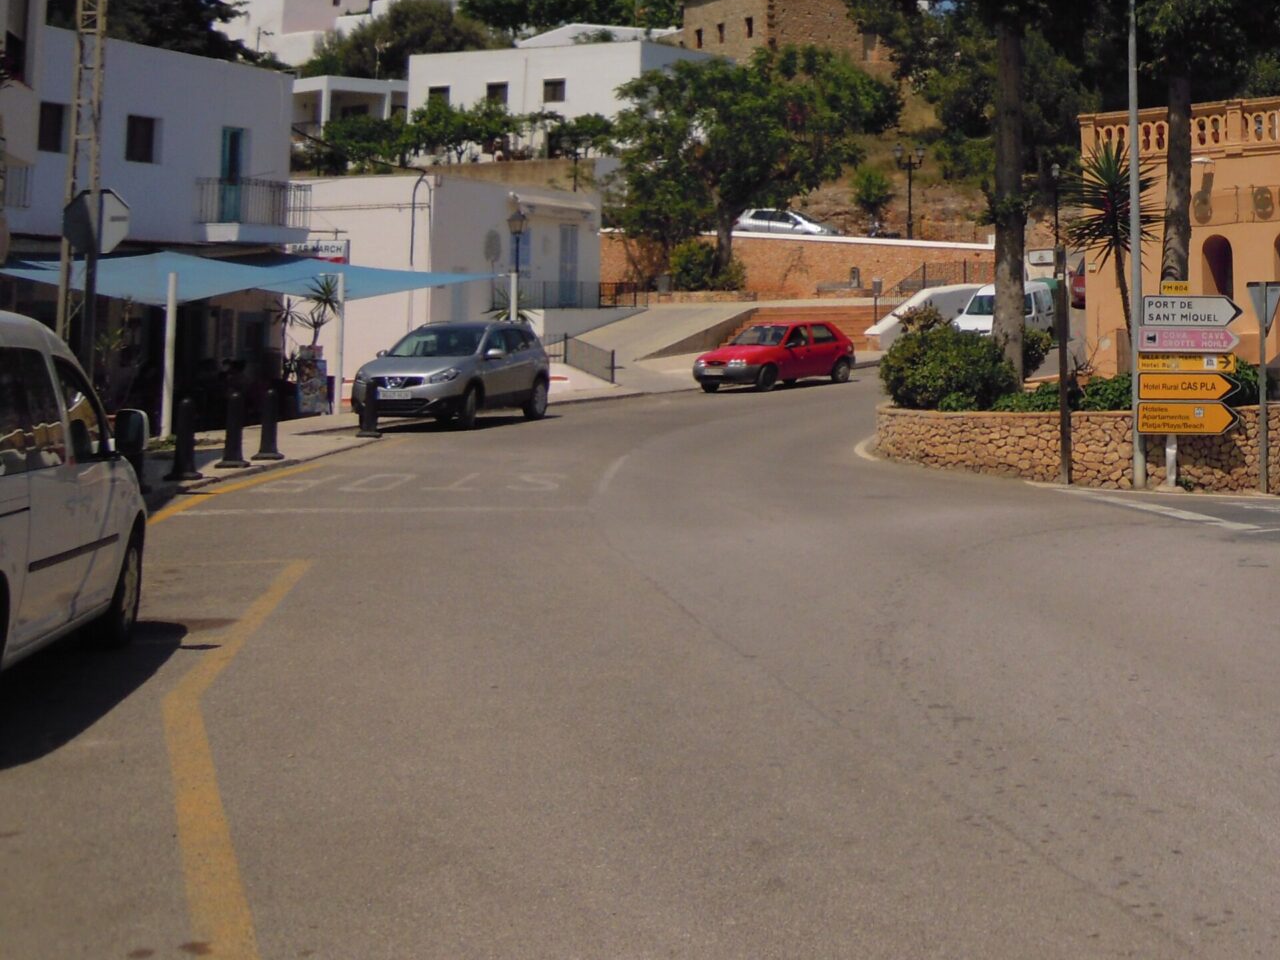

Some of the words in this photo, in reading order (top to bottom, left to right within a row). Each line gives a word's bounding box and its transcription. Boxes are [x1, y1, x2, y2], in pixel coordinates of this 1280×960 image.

[312, 244, 342, 253] MARCH
[1148, 301, 1176, 309] PORT
[1179, 301, 1193, 309] DE
[1148, 313, 1177, 321] SANT
[1180, 382, 1198, 390] CAS
[1200, 382, 1216, 391] PLA
[1142, 413, 1190, 421] Apartamentos
